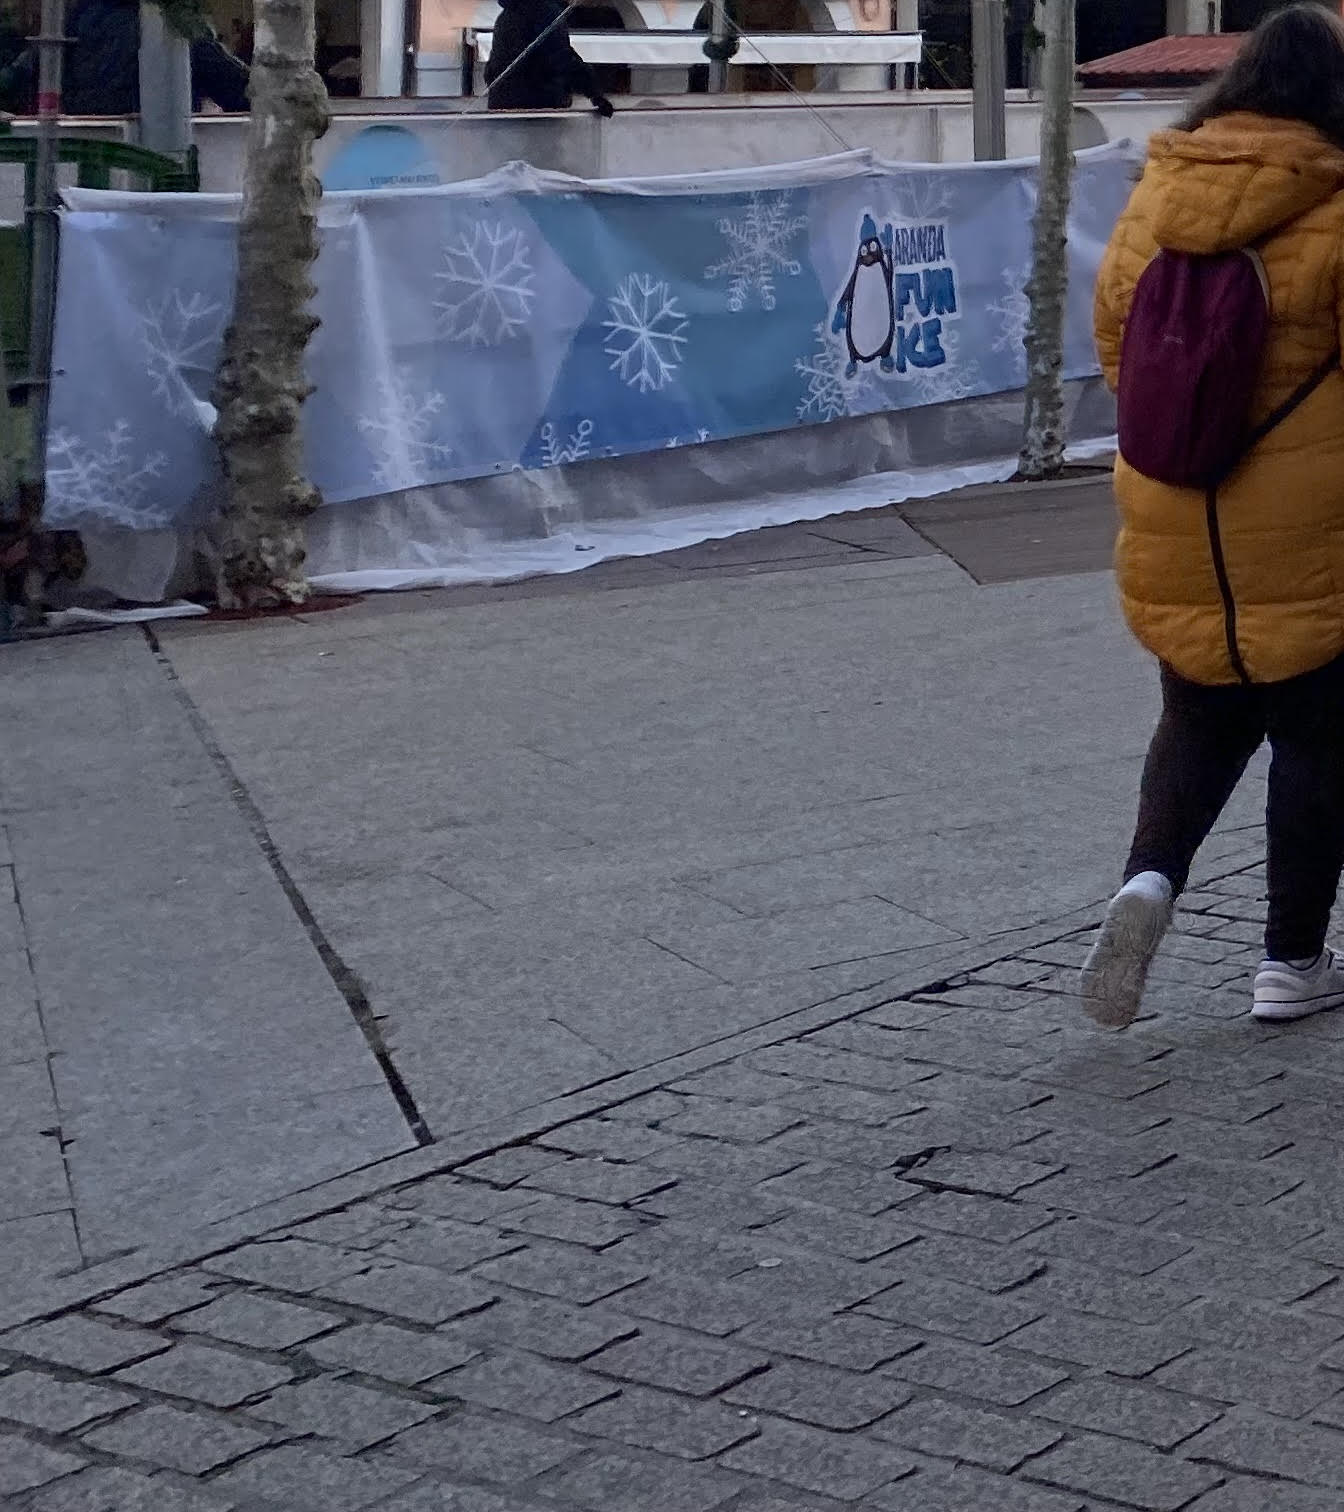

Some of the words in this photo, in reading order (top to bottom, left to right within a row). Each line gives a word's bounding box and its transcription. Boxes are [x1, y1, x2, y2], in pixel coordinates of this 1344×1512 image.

[895, 225, 945, 265] ARANDA
[895, 268, 956, 321] FUN
[896, 318, 946, 373] ICE
